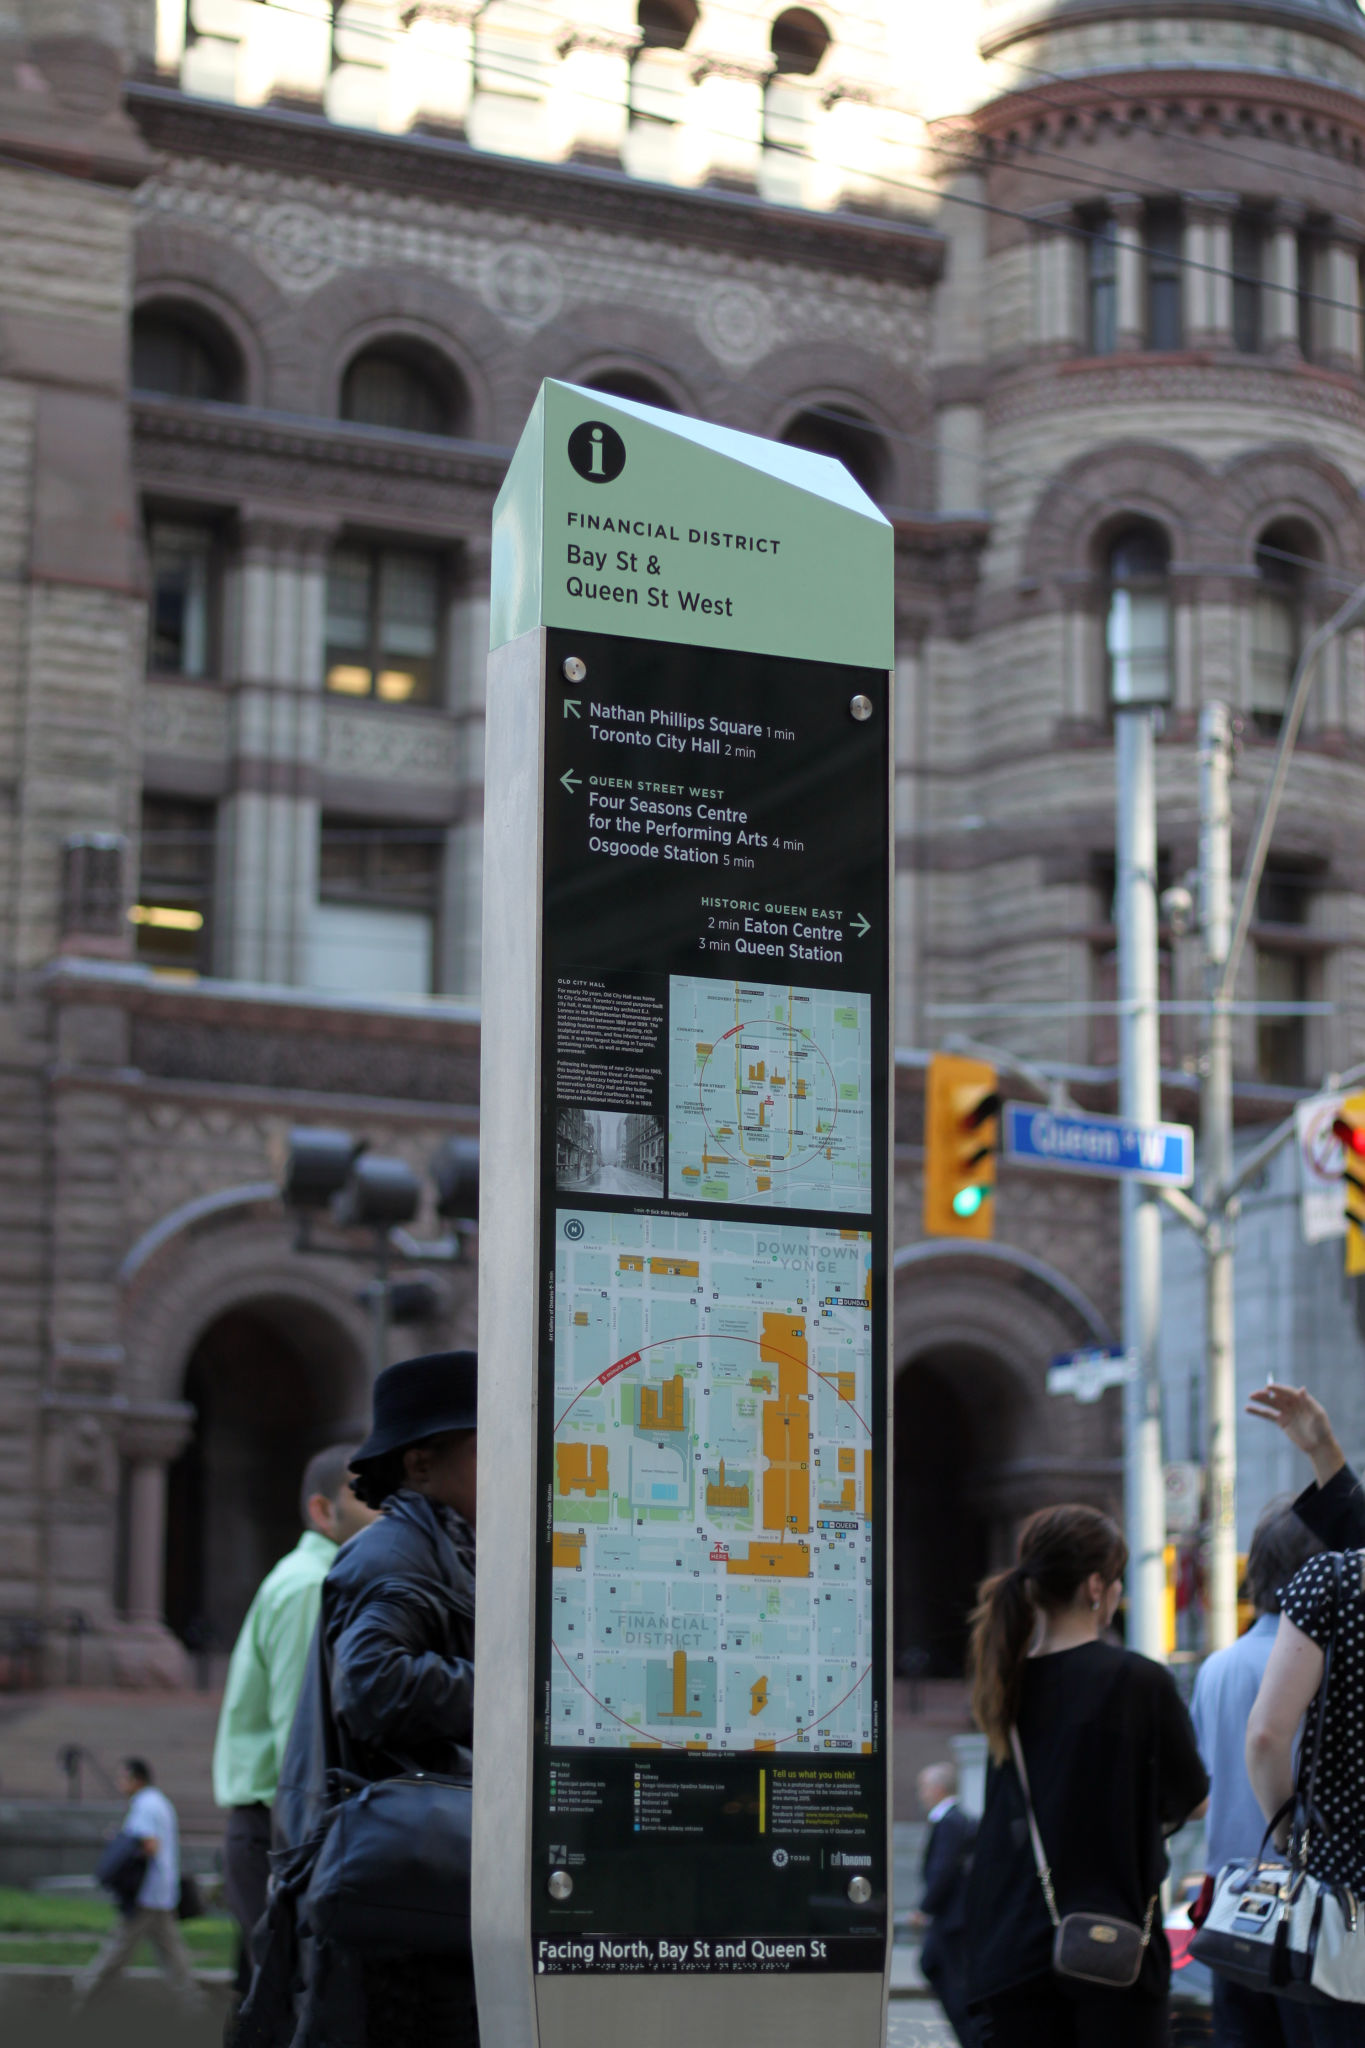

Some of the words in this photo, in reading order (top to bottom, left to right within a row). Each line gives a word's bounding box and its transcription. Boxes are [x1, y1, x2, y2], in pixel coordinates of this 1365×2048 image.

[567, 512, 680, 541] FINANCIAL
[688, 529, 781, 554] DISTRICT
[567, 544, 607, 571] Bay
[616, 551, 638, 572] St
[647, 555, 661, 575] &
[566, 576, 638, 604] Queen
[648, 587, 668, 608] St
[678, 590, 733, 616] West
[590, 703, 645, 723] Nathan
[650, 709, 704, 730] Phillips
[710, 717, 762, 738] Square
[766, 727, 772, 738] 1
[774, 728, 795, 741] min
[590, 726, 651, 746] Toronto
[656, 734, 686, 752] City
[692, 738, 720, 754] Hall
[724, 744, 732, 756] 2
[735, 746, 756, 758] min
[590, 776, 632, 790] QUEEN
[638, 781, 684, 795] STREET
[689, 786, 724, 800] WEST
[590, 792, 625, 810] Four
[630, 797, 692, 818] Seasons
[698, 805, 748, 824] Centre
[589, 814, 611, 830] for
[616, 816, 640, 832] the
[646, 820, 732, 845] Performing
[737, 830, 768, 847] Arts
[772, 838, 780, 849] 4
[784, 839, 804, 852] min
[589, 837, 659, 858] Osgoode
[664, 845, 718, 864] Station
[723, 855, 730, 866] 5
[734, 856, 754, 868] min
[701, 896, 760, 912] HISTORIC
[765, 904, 807, 917] QUEEN
[812, 909, 843, 920] EAST
[708, 918, 715, 929] 2
[719, 919, 740, 932] min
[744, 918, 788, 936] Eaton
[793, 924, 843, 941] Centre
[699, 938, 706, 949] 3
[710, 939, 730, 952] min
[735, 938, 784, 957] Queen
[789, 944, 843, 962] Station
[1030, 1112, 1121, 1163] Queen
[1138, 1131, 1166, 1169] W
[758, 1241, 859, 1260] DOWNTOWN
[780, 1259, 837, 1273] YONGE
[618, 1615, 709, 1630] FINANCIAL
[626, 1632, 702, 1646] DISTRICT
[834, 1771, 855, 1779] think!
[842, 1854, 871, 1866] TORONTO
[539, 1942, 594, 1961] Facing
[600, 1942, 654, 1960] North,
[659, 1942, 688, 1961] Bay
[694, 1942, 710, 1959] St
[715, 1941, 746, 1958] and
[751, 1942, 805, 1960] Queen
[810, 1941, 826, 1958] St
